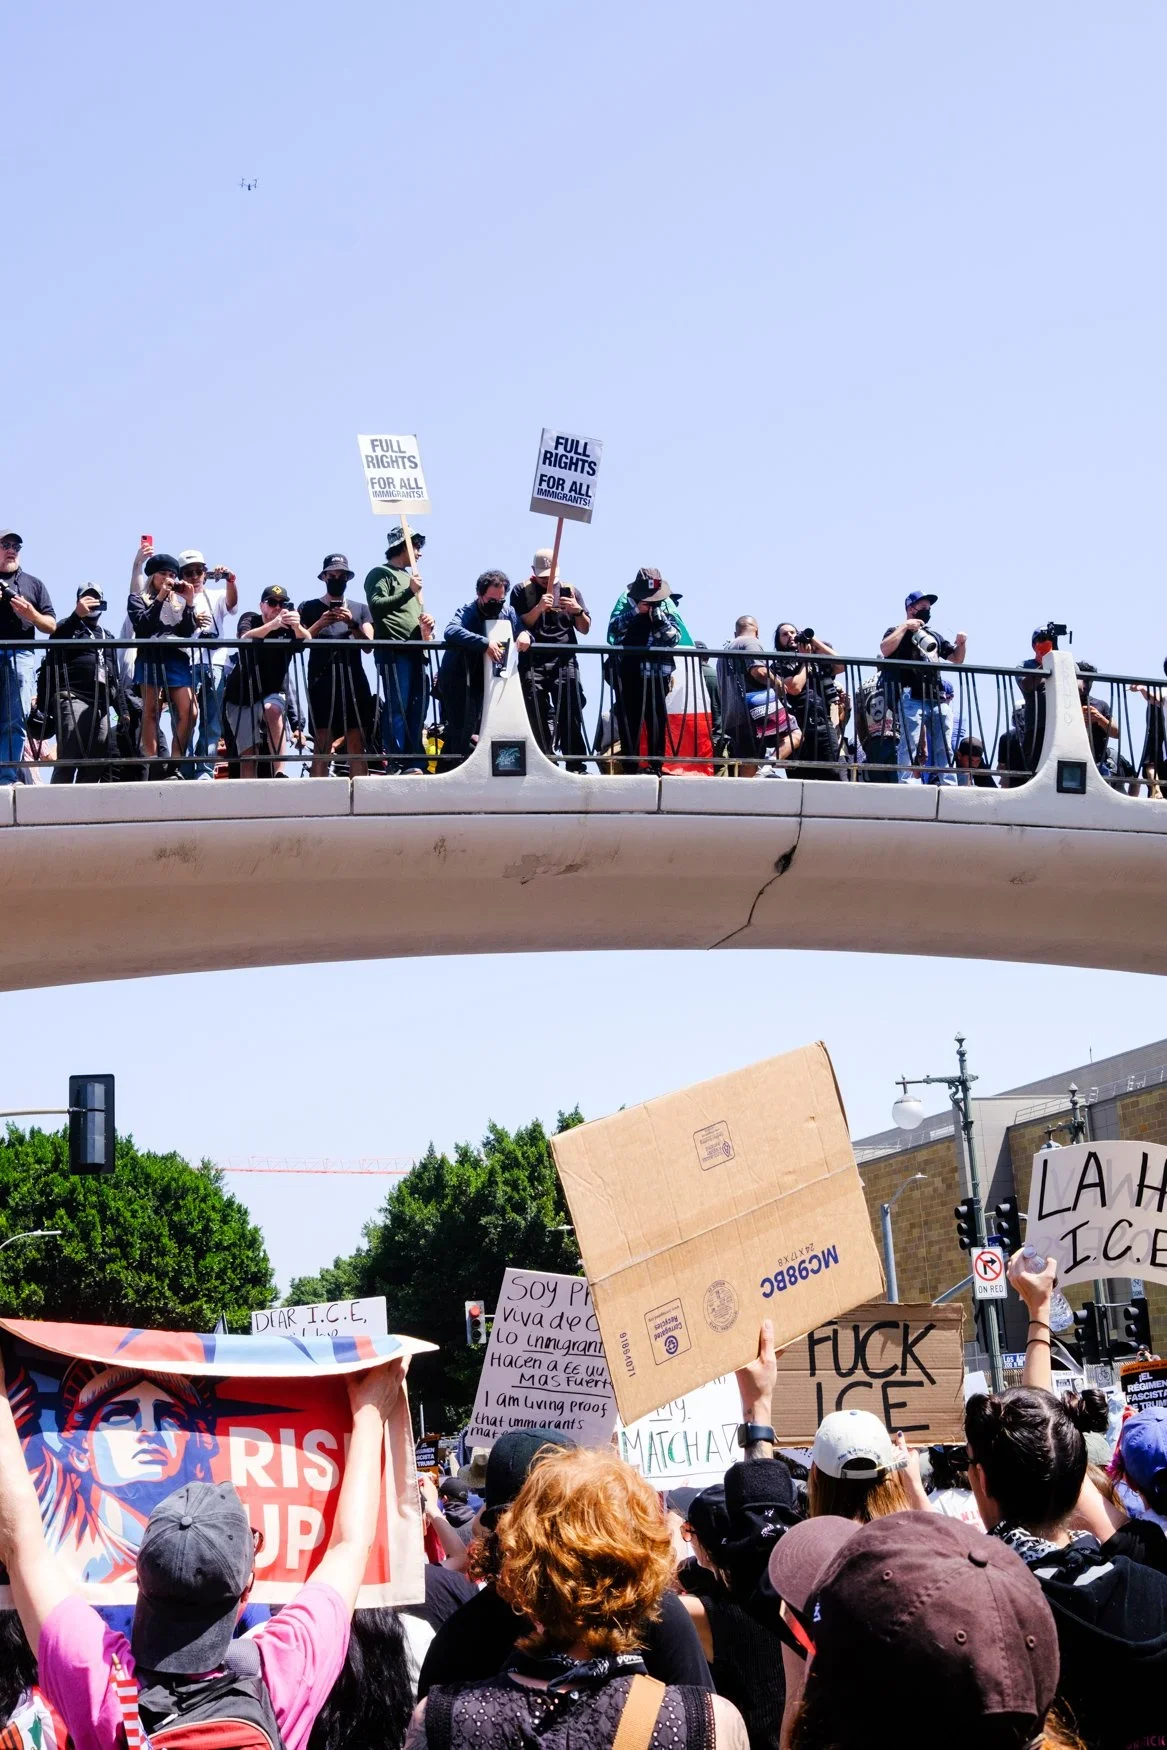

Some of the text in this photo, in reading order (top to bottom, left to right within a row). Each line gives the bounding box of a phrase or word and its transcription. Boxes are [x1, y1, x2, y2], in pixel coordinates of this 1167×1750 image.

[370, 438, 407, 454] FULL
[554, 435, 591, 458] FULL
[364, 454, 419, 470] RIGHTS
[542, 449, 597, 477] RIGHTS
[369, 476, 424, 490] FOR ALL
[538, 473, 592, 499] FOR ALL
[372, 489, 424, 499] IMMIGRANTS!
[536, 487, 591, 507] IMMIGRANTS!
[760, 1244, 839, 1299] MC98BC
[978, 1285, 1004, 1294] ON RED
[254, 1307, 298, 1333] DEAR
[654, 1315, 679, 1331] Recycles
[653, 1322, 683, 1342] Corrugated
[807, 1320, 937, 1385] FUCK
[496, 1392, 520, 1408] am
[569, 1401, 609, 1418] proof
